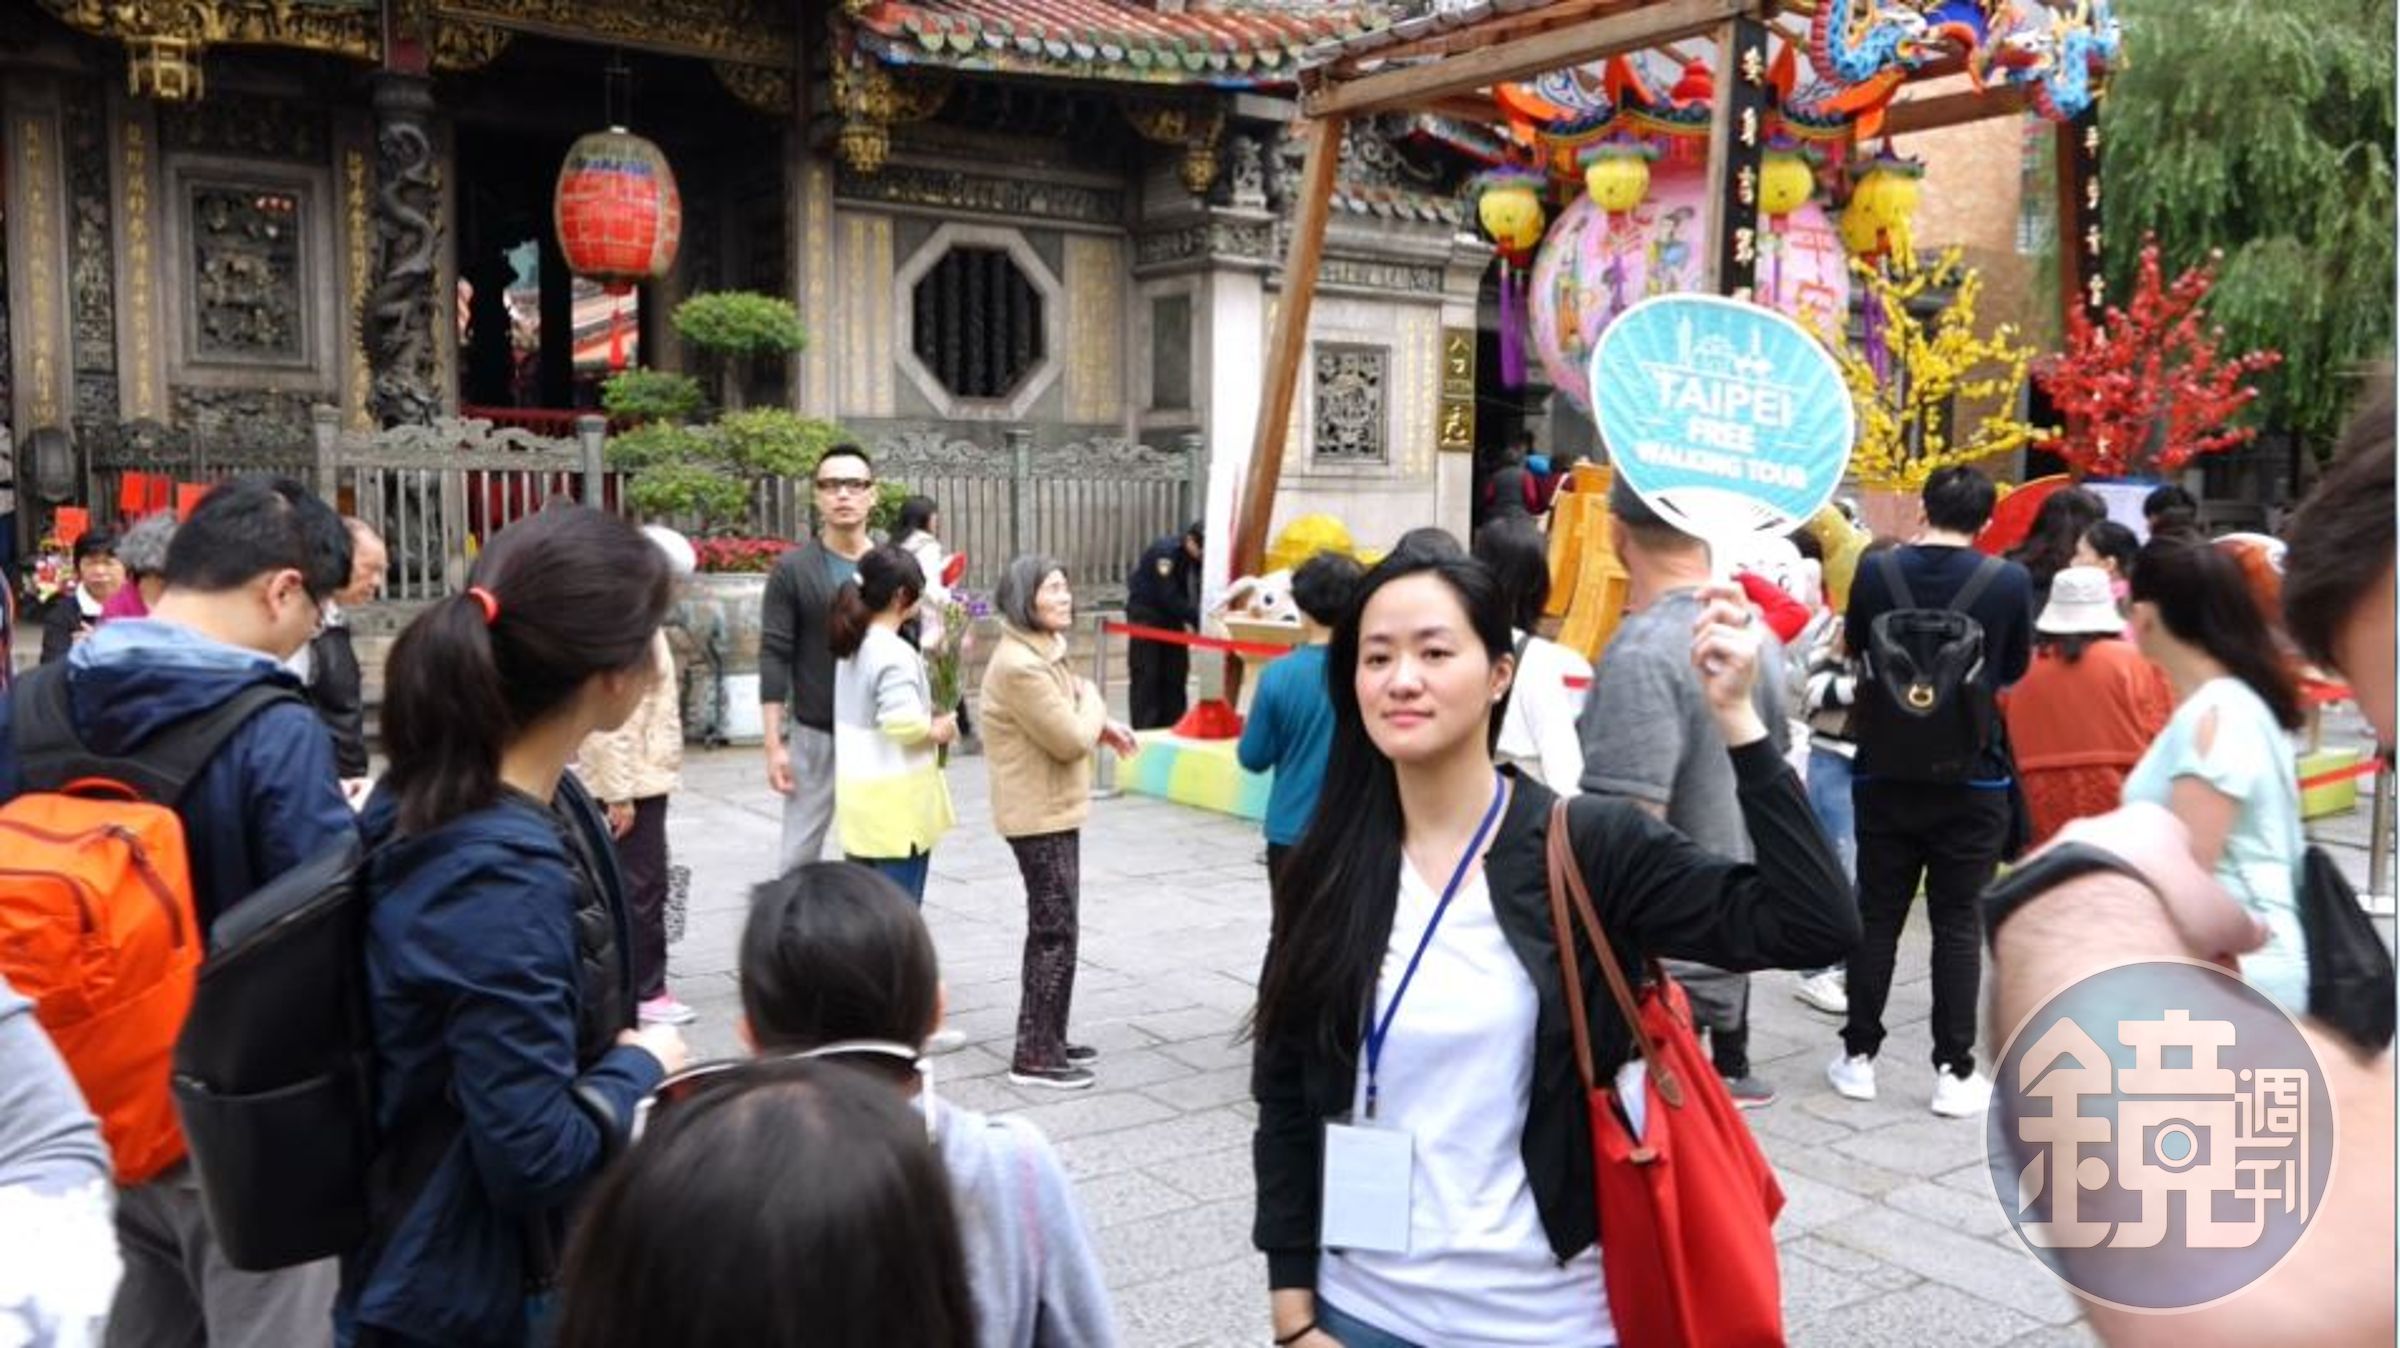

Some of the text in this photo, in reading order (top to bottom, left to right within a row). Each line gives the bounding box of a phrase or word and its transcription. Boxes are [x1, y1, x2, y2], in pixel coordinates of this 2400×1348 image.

[1652, 371, 1792, 428] TAIPEI
[1689, 416, 1755, 452] FREE
[1634, 441, 1808, 490] WALKING TOUR
